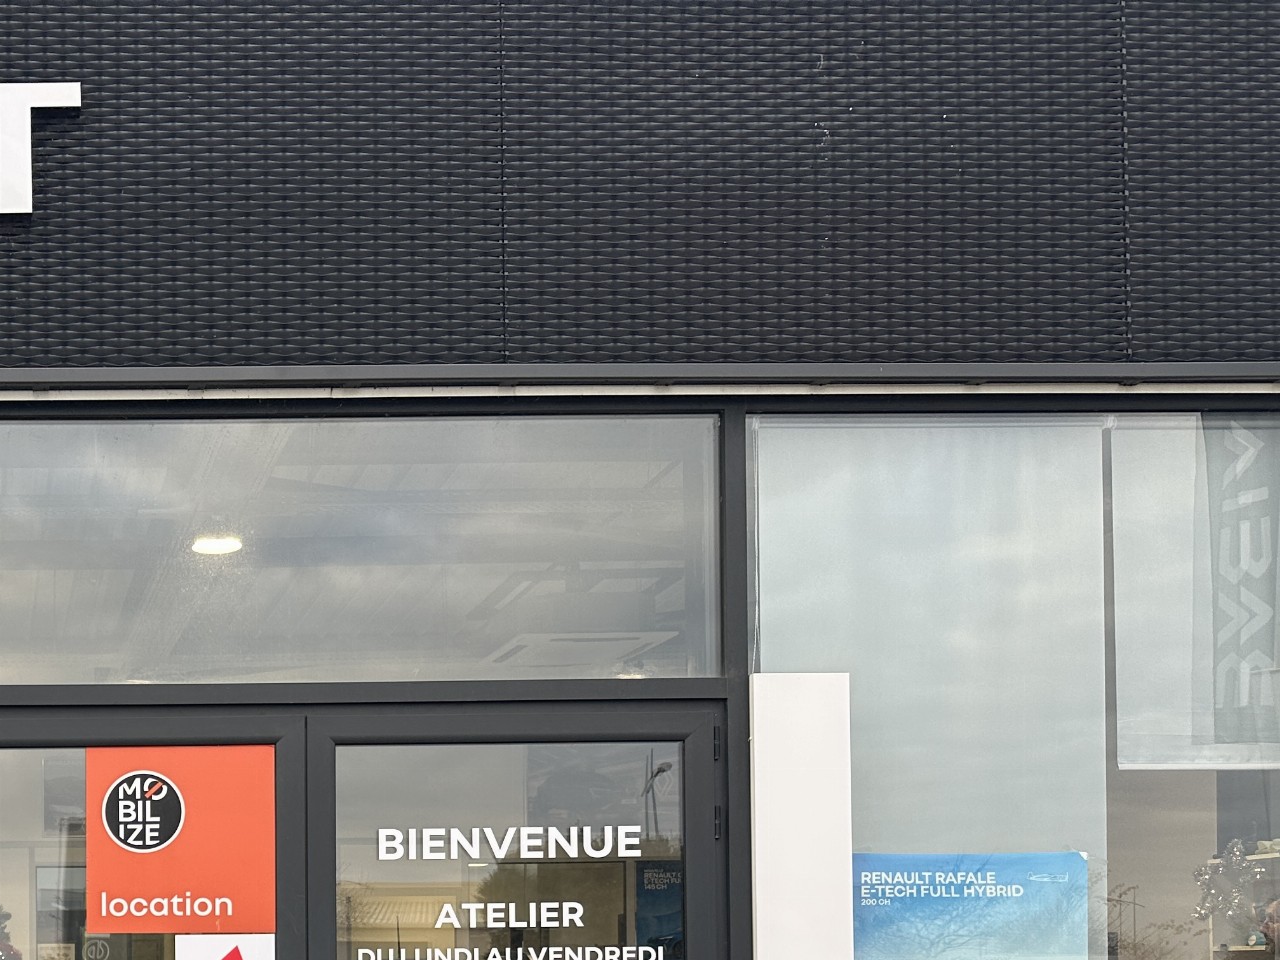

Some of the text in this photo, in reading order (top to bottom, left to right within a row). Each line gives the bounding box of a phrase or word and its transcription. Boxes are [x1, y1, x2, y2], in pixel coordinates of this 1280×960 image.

[377, 825, 642, 861] BIENVENUE
[861, 872, 996, 884] RENAULT RAFALE
[100, 891, 233, 917] location
[861, 885, 1024, 898] E-TECH FULL HYBRID
[434, 902, 585, 929] ATELIER
